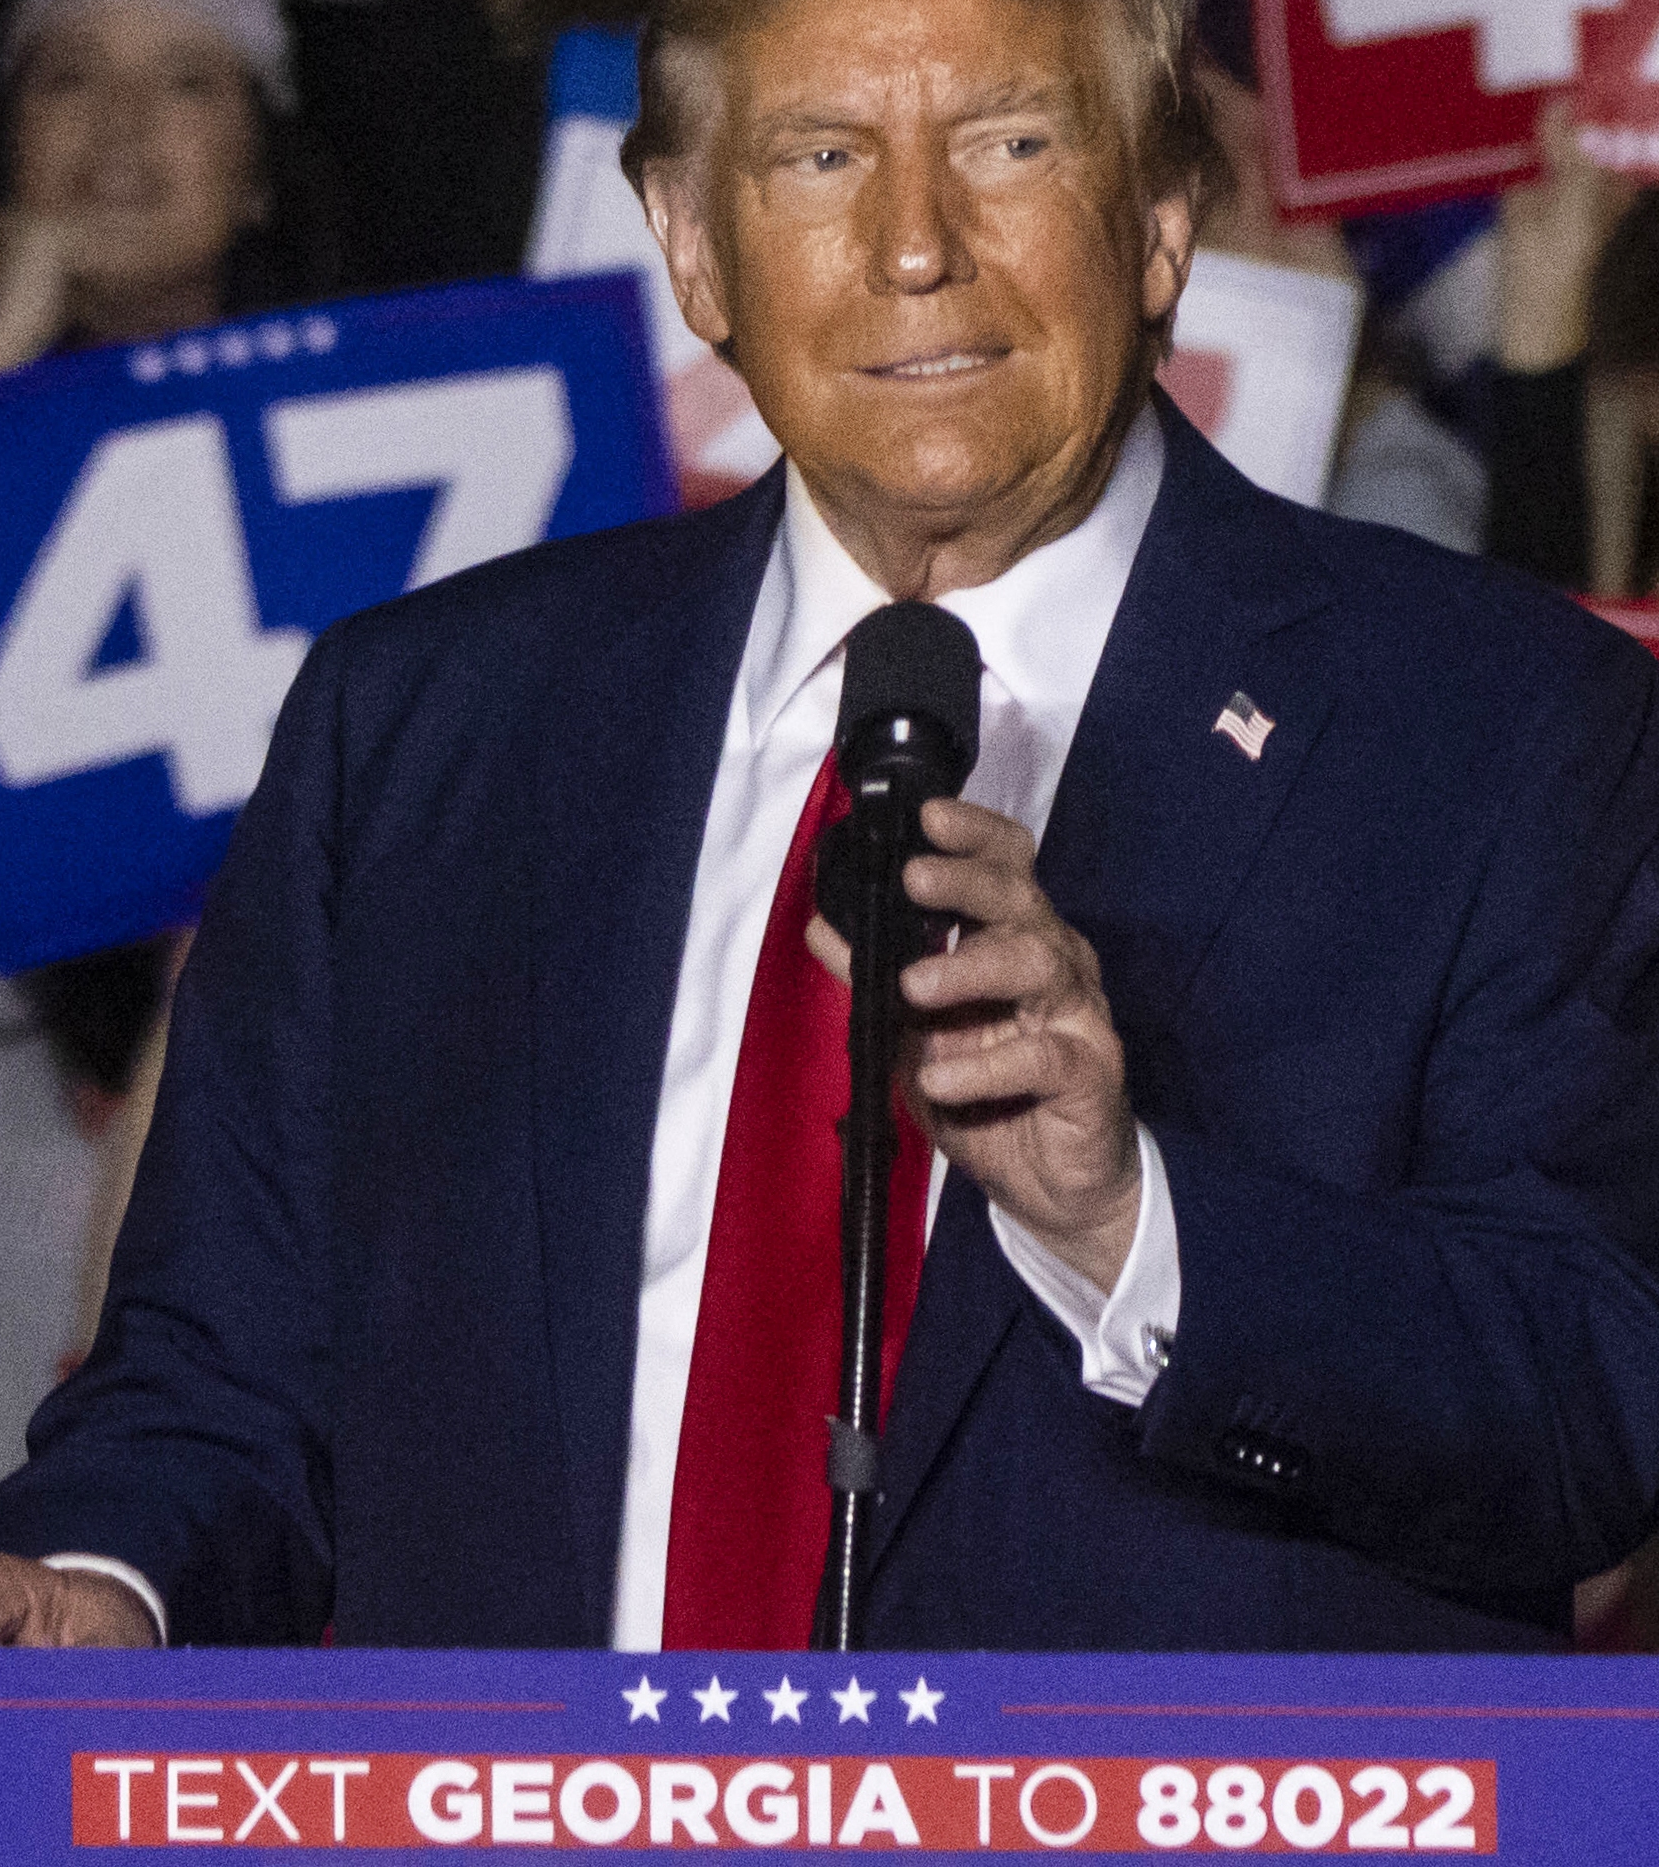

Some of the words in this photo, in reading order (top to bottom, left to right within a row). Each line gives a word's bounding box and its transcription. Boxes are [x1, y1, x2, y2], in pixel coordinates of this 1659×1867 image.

[94, 1759, 370, 1842] TEXT
[406, 1760, 921, 1847] GEORGIA
[954, 1764, 1098, 1848] TO
[1137, 1765, 1476, 1849] 88022
